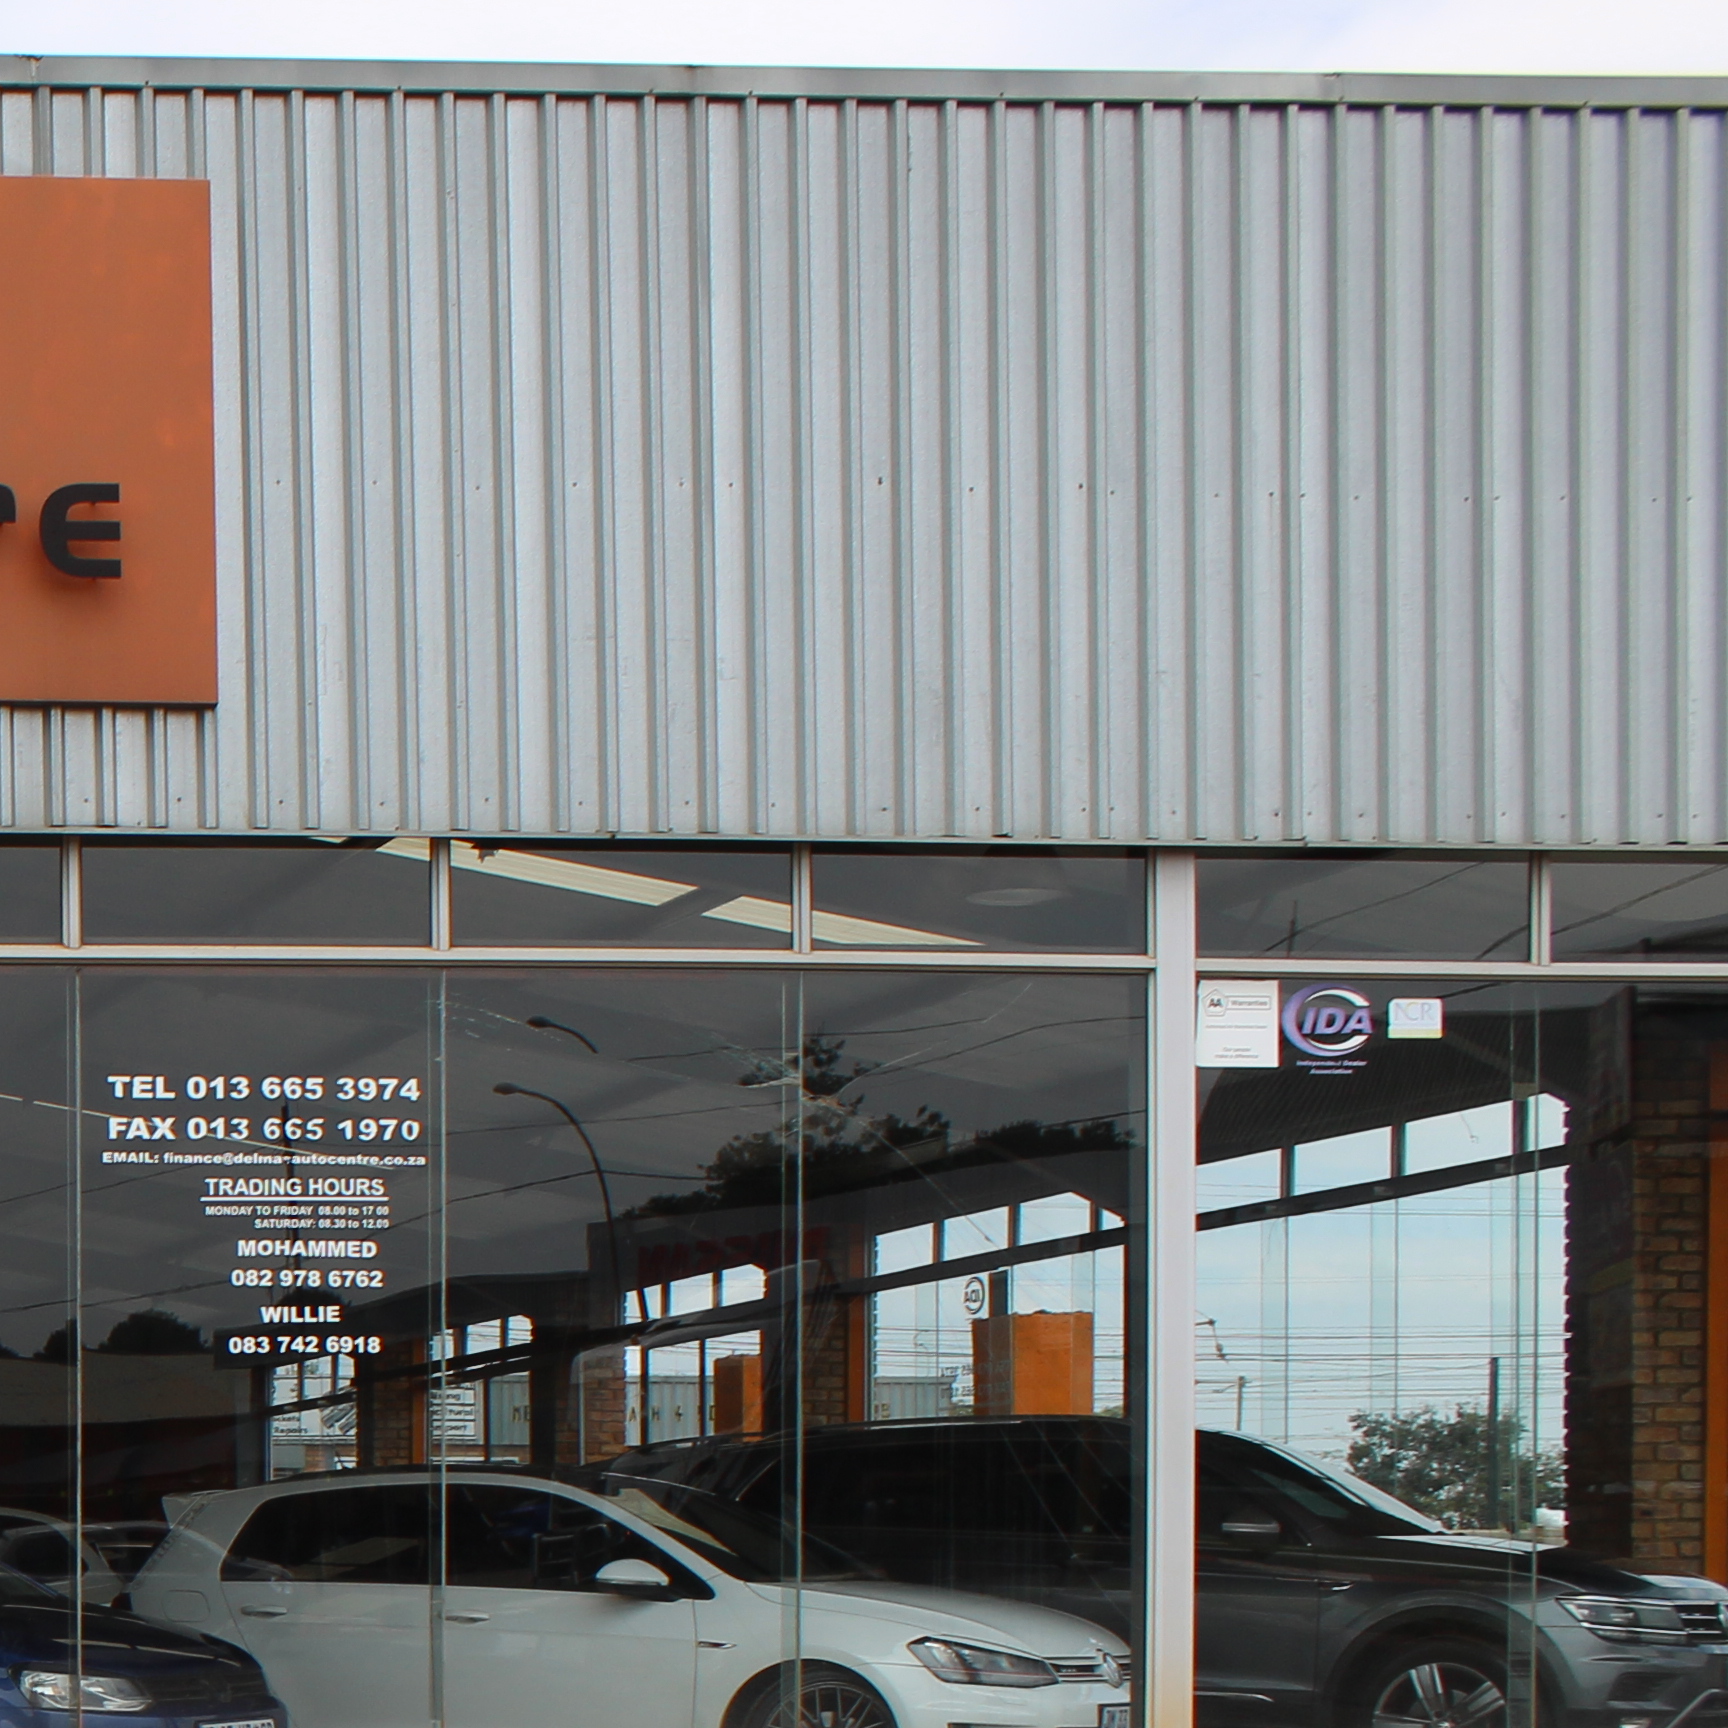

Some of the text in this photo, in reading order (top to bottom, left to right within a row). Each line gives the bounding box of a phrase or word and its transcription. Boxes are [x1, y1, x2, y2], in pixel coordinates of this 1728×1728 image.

[1394, 1001, 1435, 1021] NCR
[1301, 1007, 1373, 1034] IDA
[107, 1076, 421, 1100] TEL 013 665 3974
[108, 1117, 420, 1140] FAX 013 665 1970
[102, 1152, 159, 1164] EMAIL:
[205, 1178, 384, 1196] TRADING HOURS
[205, 1206, 252, 1216] MONDAY
[256, 1206, 271, 1216] TO
[273, 1206, 312, 1216] FRIDAY
[348, 1207, 359, 1215] to
[254, 1219, 316, 1229] SATURDAY:
[348, 1219, 359, 1228] to
[237, 1240, 377, 1258] MOHAMMED
[231, 1269, 383, 1288] 082 978 6762
[260, 1306, 341, 1324] WILLIE
[228, 1336, 381, 1354] 083 742 6918
